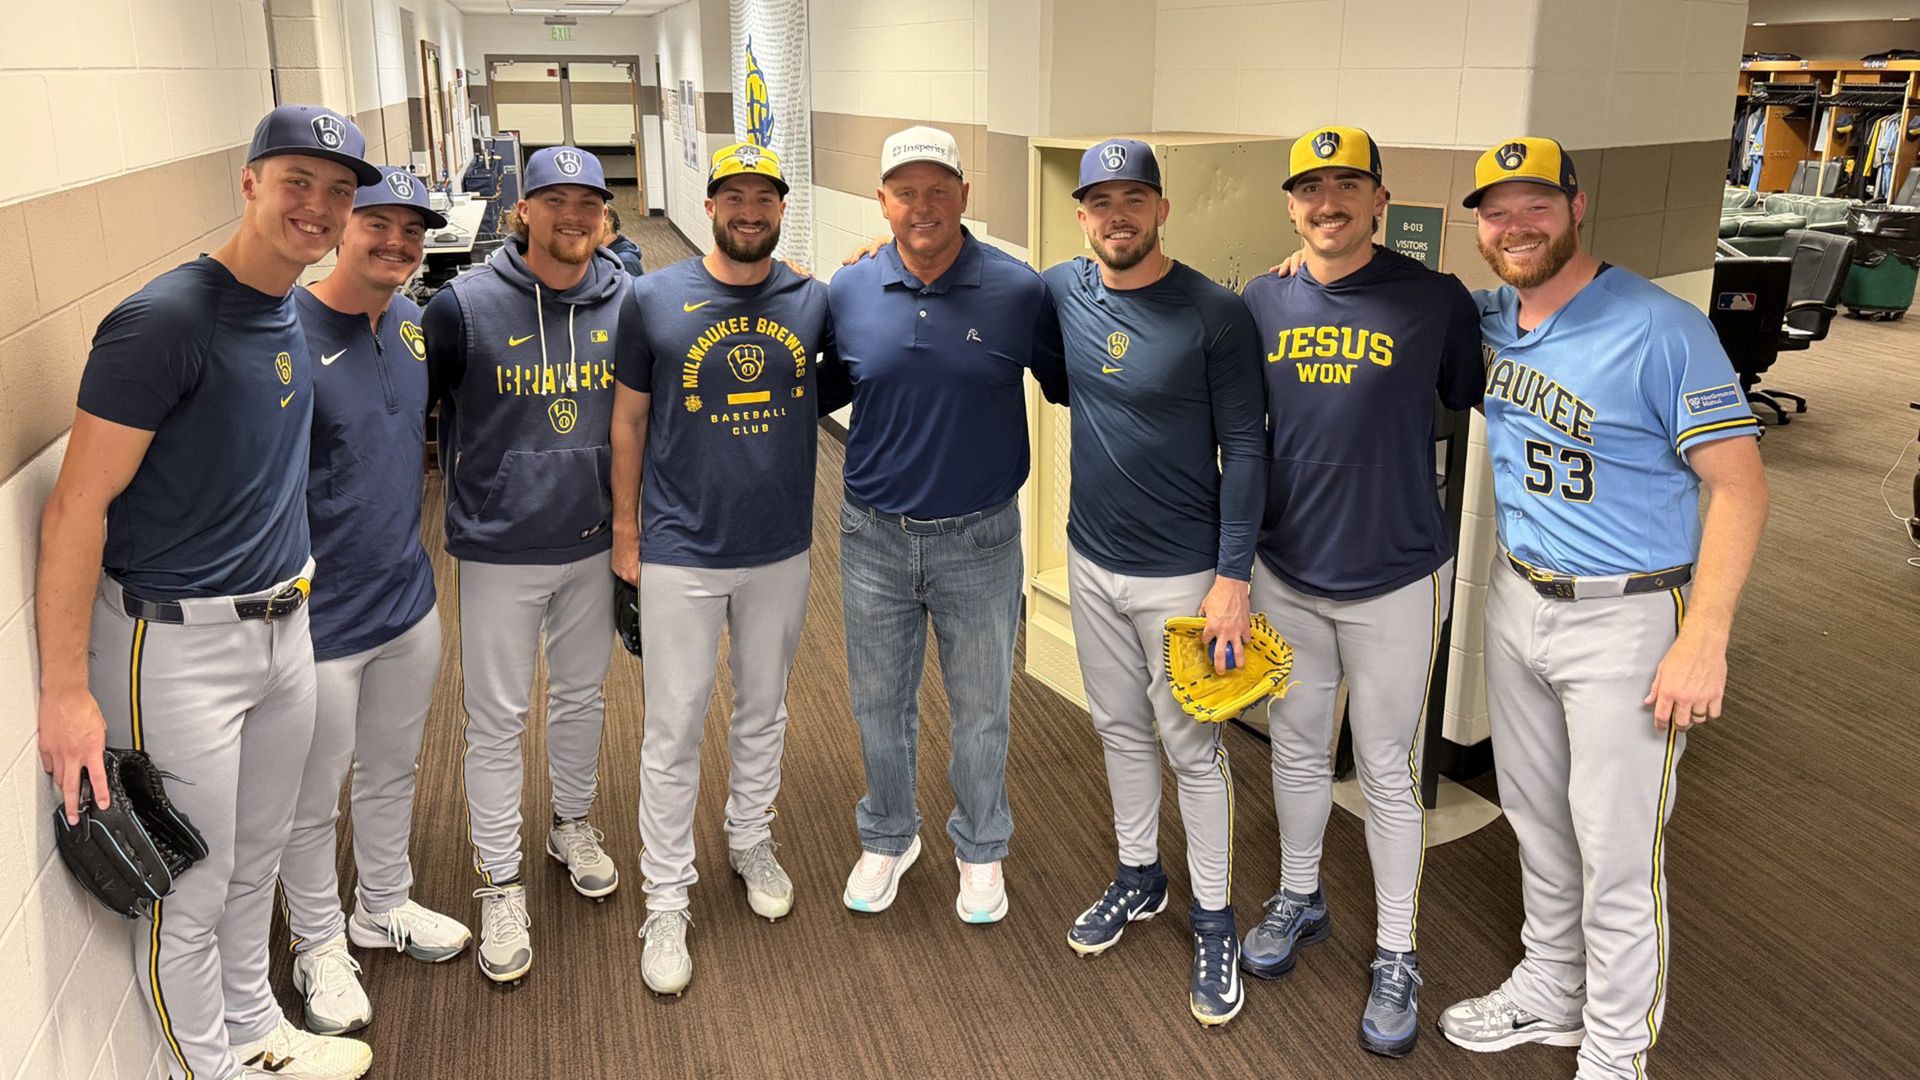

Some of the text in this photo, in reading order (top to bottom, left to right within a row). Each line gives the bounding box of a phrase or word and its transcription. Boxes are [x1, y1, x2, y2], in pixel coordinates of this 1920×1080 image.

[551, 26, 572, 41] EXIT
[903, 143, 947, 156] Insperity
[1395, 240, 1428, 250] VISITORS
[1397, 250, 1426, 260] OCKER
[682, 316, 807, 389] MILWAUKEE BREWERS
[1267, 326, 1394, 367] JESUS
[1295, 363, 1358, 384] WON
[710, 408, 786, 423] BASEBALL
[732, 423, 769, 435] CLUB
[1524, 438, 1595, 503] 53
